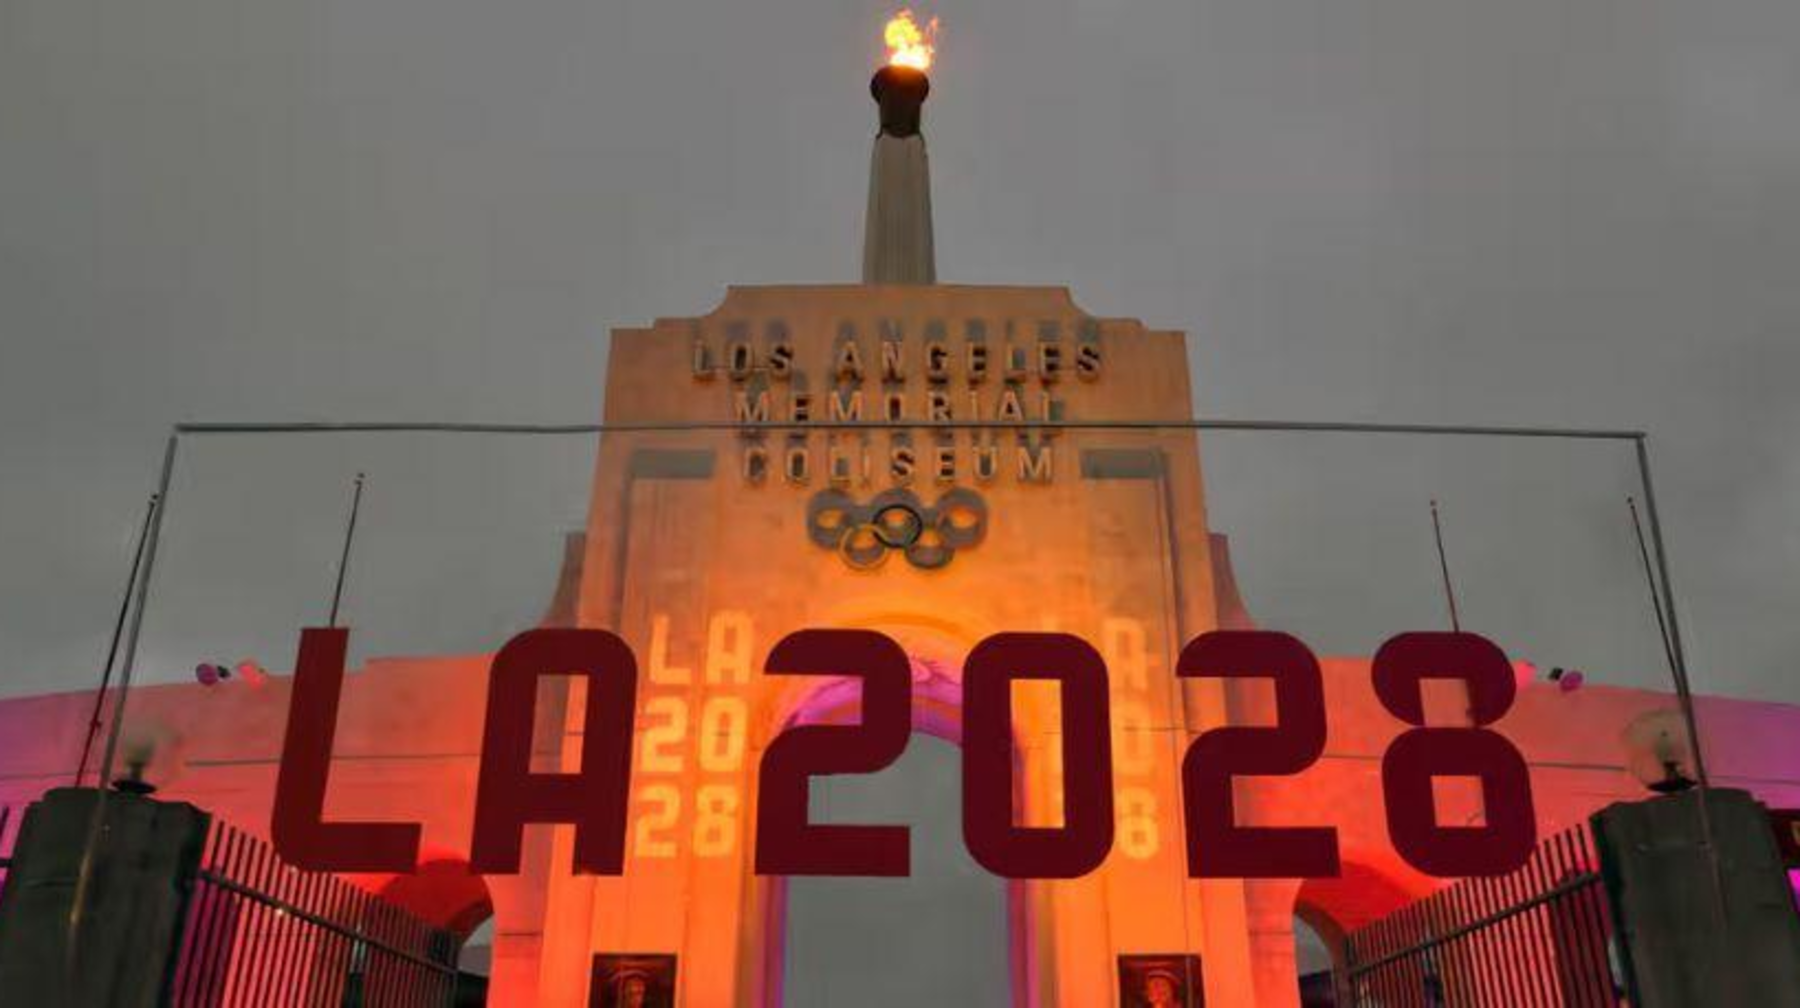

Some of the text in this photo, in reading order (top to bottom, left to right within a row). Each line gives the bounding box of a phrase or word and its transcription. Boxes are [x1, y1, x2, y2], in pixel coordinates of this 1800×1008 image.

[692, 340, 1102, 378] LOS ANGELES
[735, 391, 1063, 426] MEMORIAL
[743, 447, 1053, 481] COLISEUM
[650, 610, 752, 684] LA
[272, 628, 1537, 879] LA 2028
[641, 696, 748, 772] 20
[634, 784, 738, 858] 28
